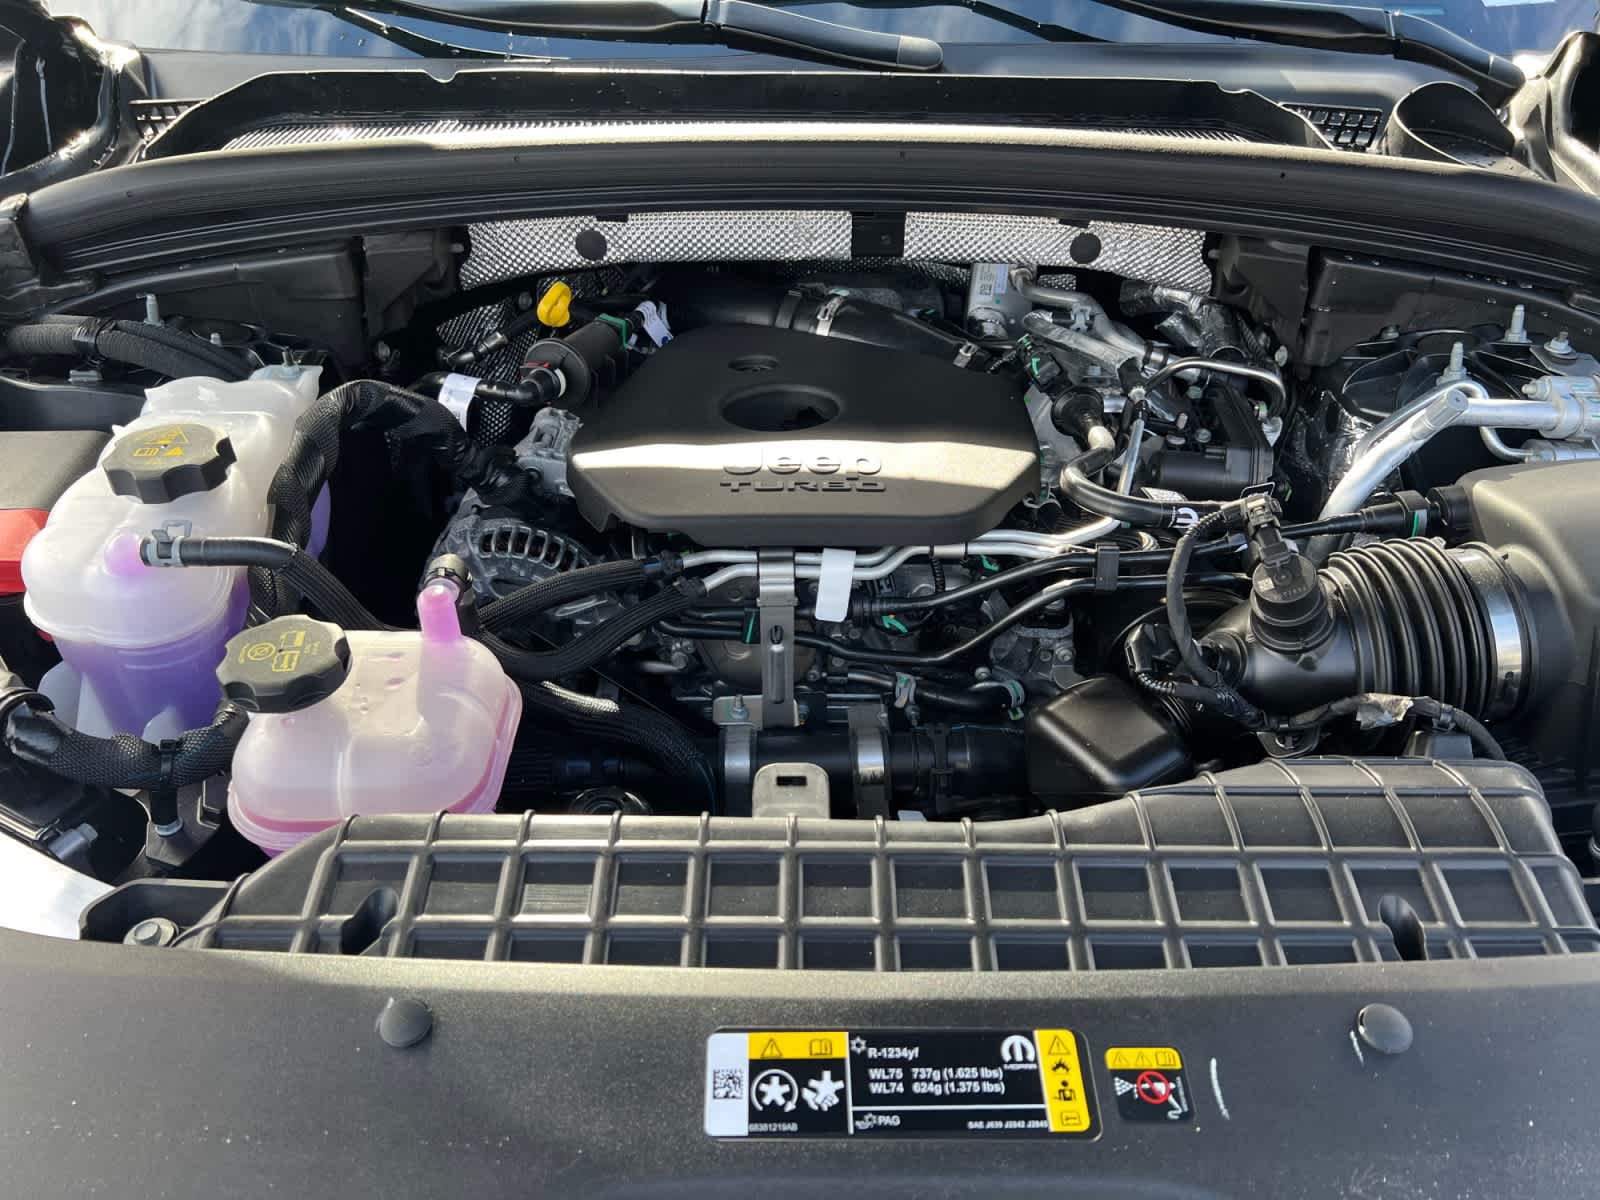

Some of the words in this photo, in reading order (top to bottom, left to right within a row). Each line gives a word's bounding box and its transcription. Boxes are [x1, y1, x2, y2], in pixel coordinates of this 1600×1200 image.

[720, 480, 887, 493] TURBO
[868, 1047, 919, 1061] R-1234yf
[868, 1068, 903, 1080] WL75
[911, 1067, 941, 1081] 737g
[943, 1067, 978, 1081] (1.625
[980, 1066, 1003, 1080] lbs)
[869, 1082, 904, 1094] WL74
[912, 1082, 942, 1095] 624g
[944, 1081, 980, 1095] (1.375
[981, 1081, 1005, 1095] lbs)
[878, 1115, 901, 1126] PAG
